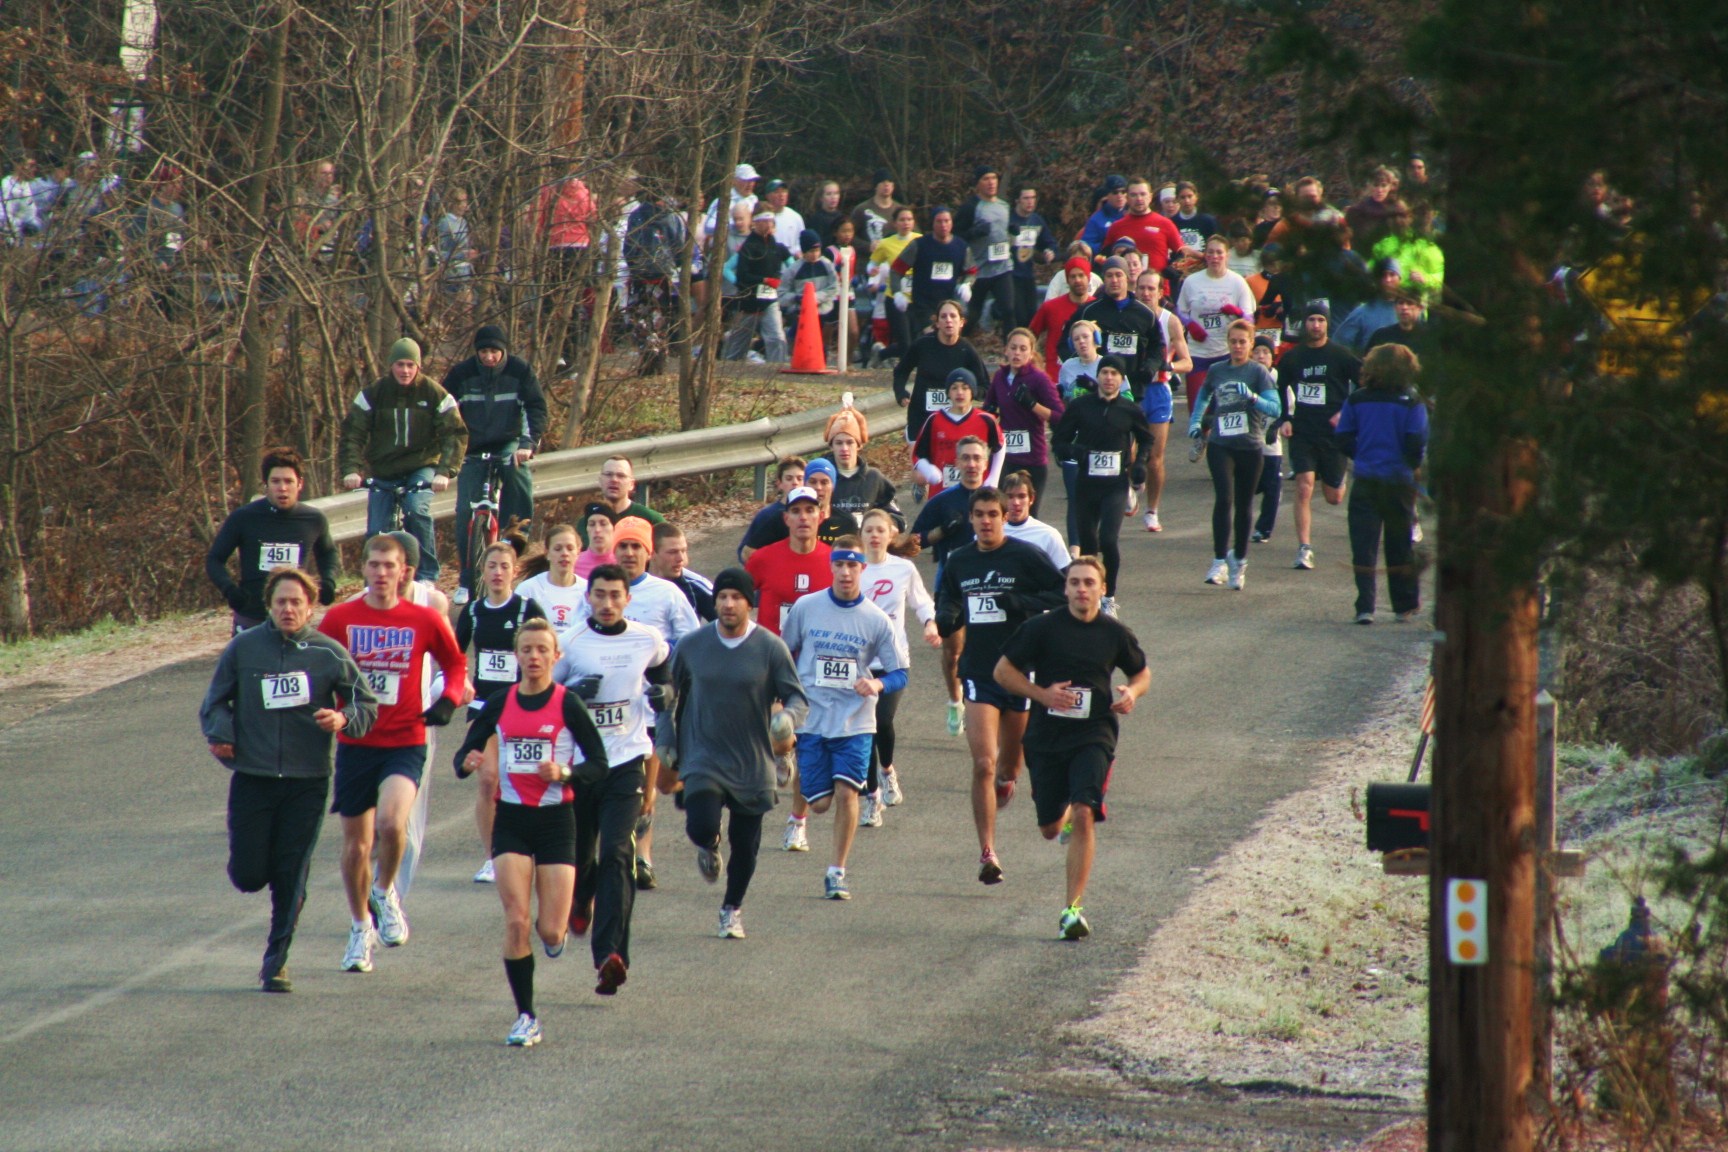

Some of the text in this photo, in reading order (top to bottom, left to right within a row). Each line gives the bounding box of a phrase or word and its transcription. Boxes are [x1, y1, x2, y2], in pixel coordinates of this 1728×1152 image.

[1113, 335, 1132, 346] 530
[1302, 386, 1320, 396] 172
[1223, 415, 1242, 428] 372
[1094, 455, 1113, 467] 261
[267, 547, 291, 561] 451
[557, 609, 566, 621] S
[809, 629, 868, 647] NEW HAVEN
[488, 654, 506, 669] 45
[823, 661, 849, 677] 644
[269, 676, 300, 696] 703
[595, 706, 624, 725] 514
[513, 742, 543, 760] 536
